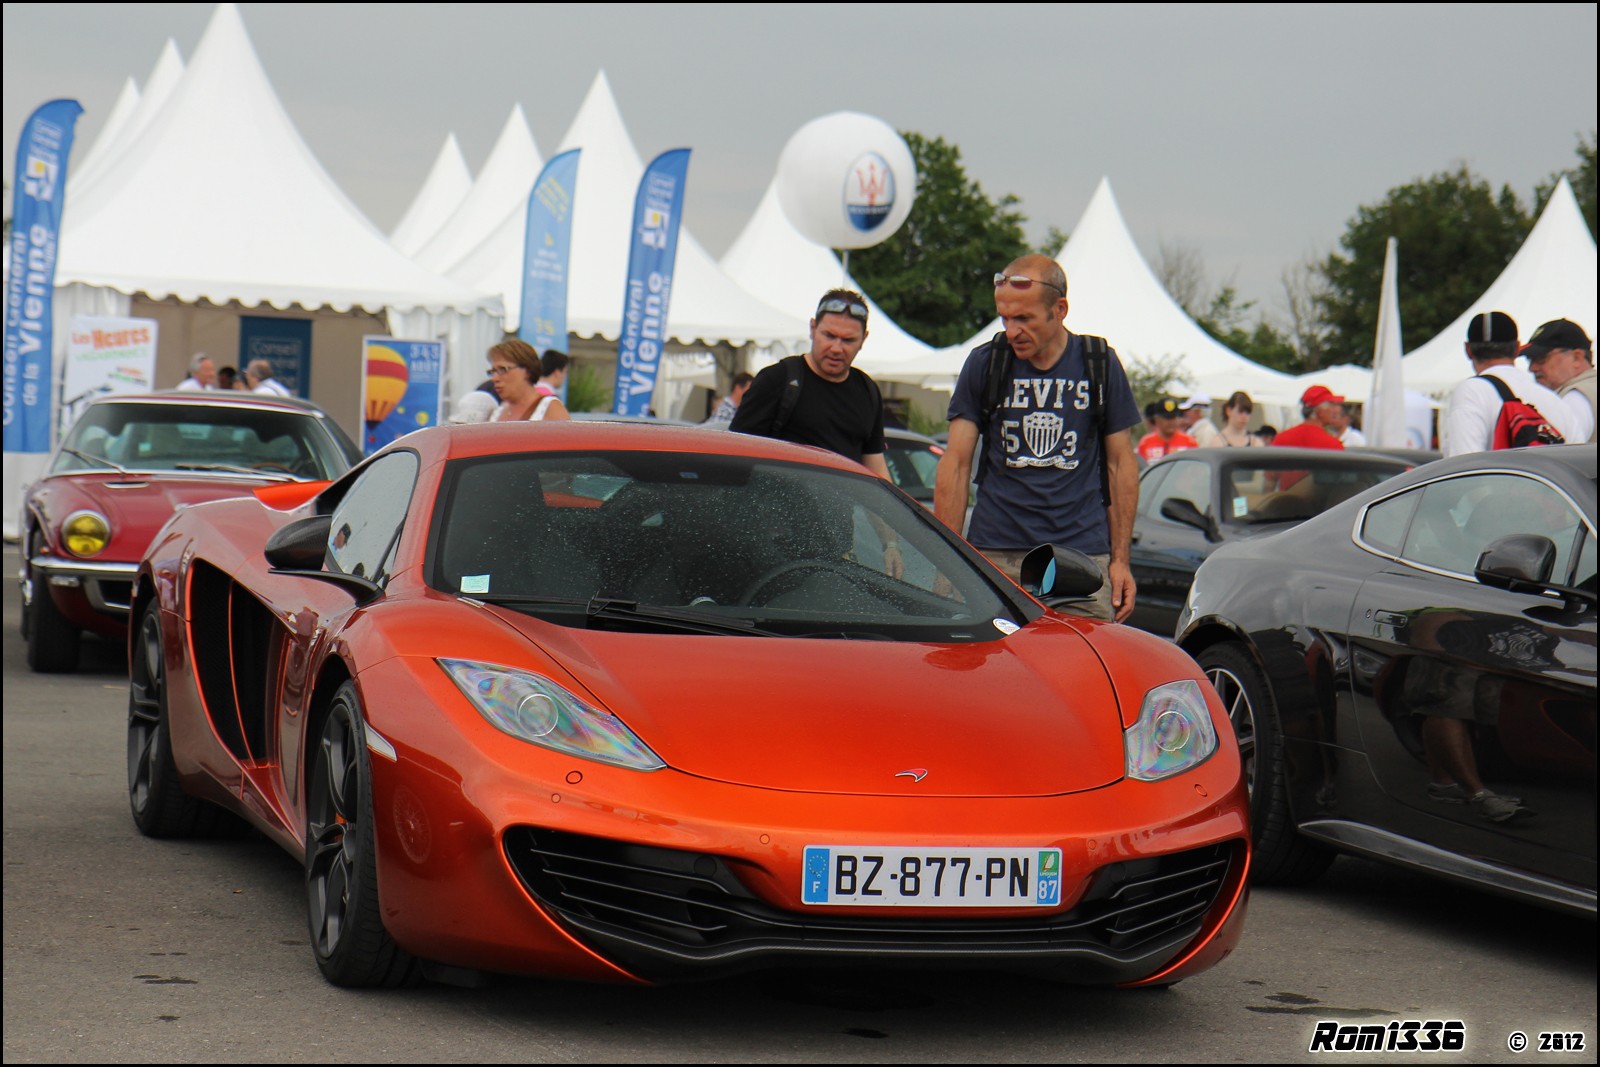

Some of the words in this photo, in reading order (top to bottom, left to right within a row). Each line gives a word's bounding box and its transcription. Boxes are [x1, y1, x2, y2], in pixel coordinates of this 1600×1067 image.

[18, 223, 48, 356] Vienne
[629, 271, 662, 396] Vienne
[23, 363, 39, 379] la
[23, 382, 38, 406] de
[1001, 421, 1019, 453] 5
[1062, 431, 1077, 456] 3
[812, 882, 820, 893] F
[835, 855, 1029, 897] BZ-877-PN
[1038, 880, 1057, 899] 87
